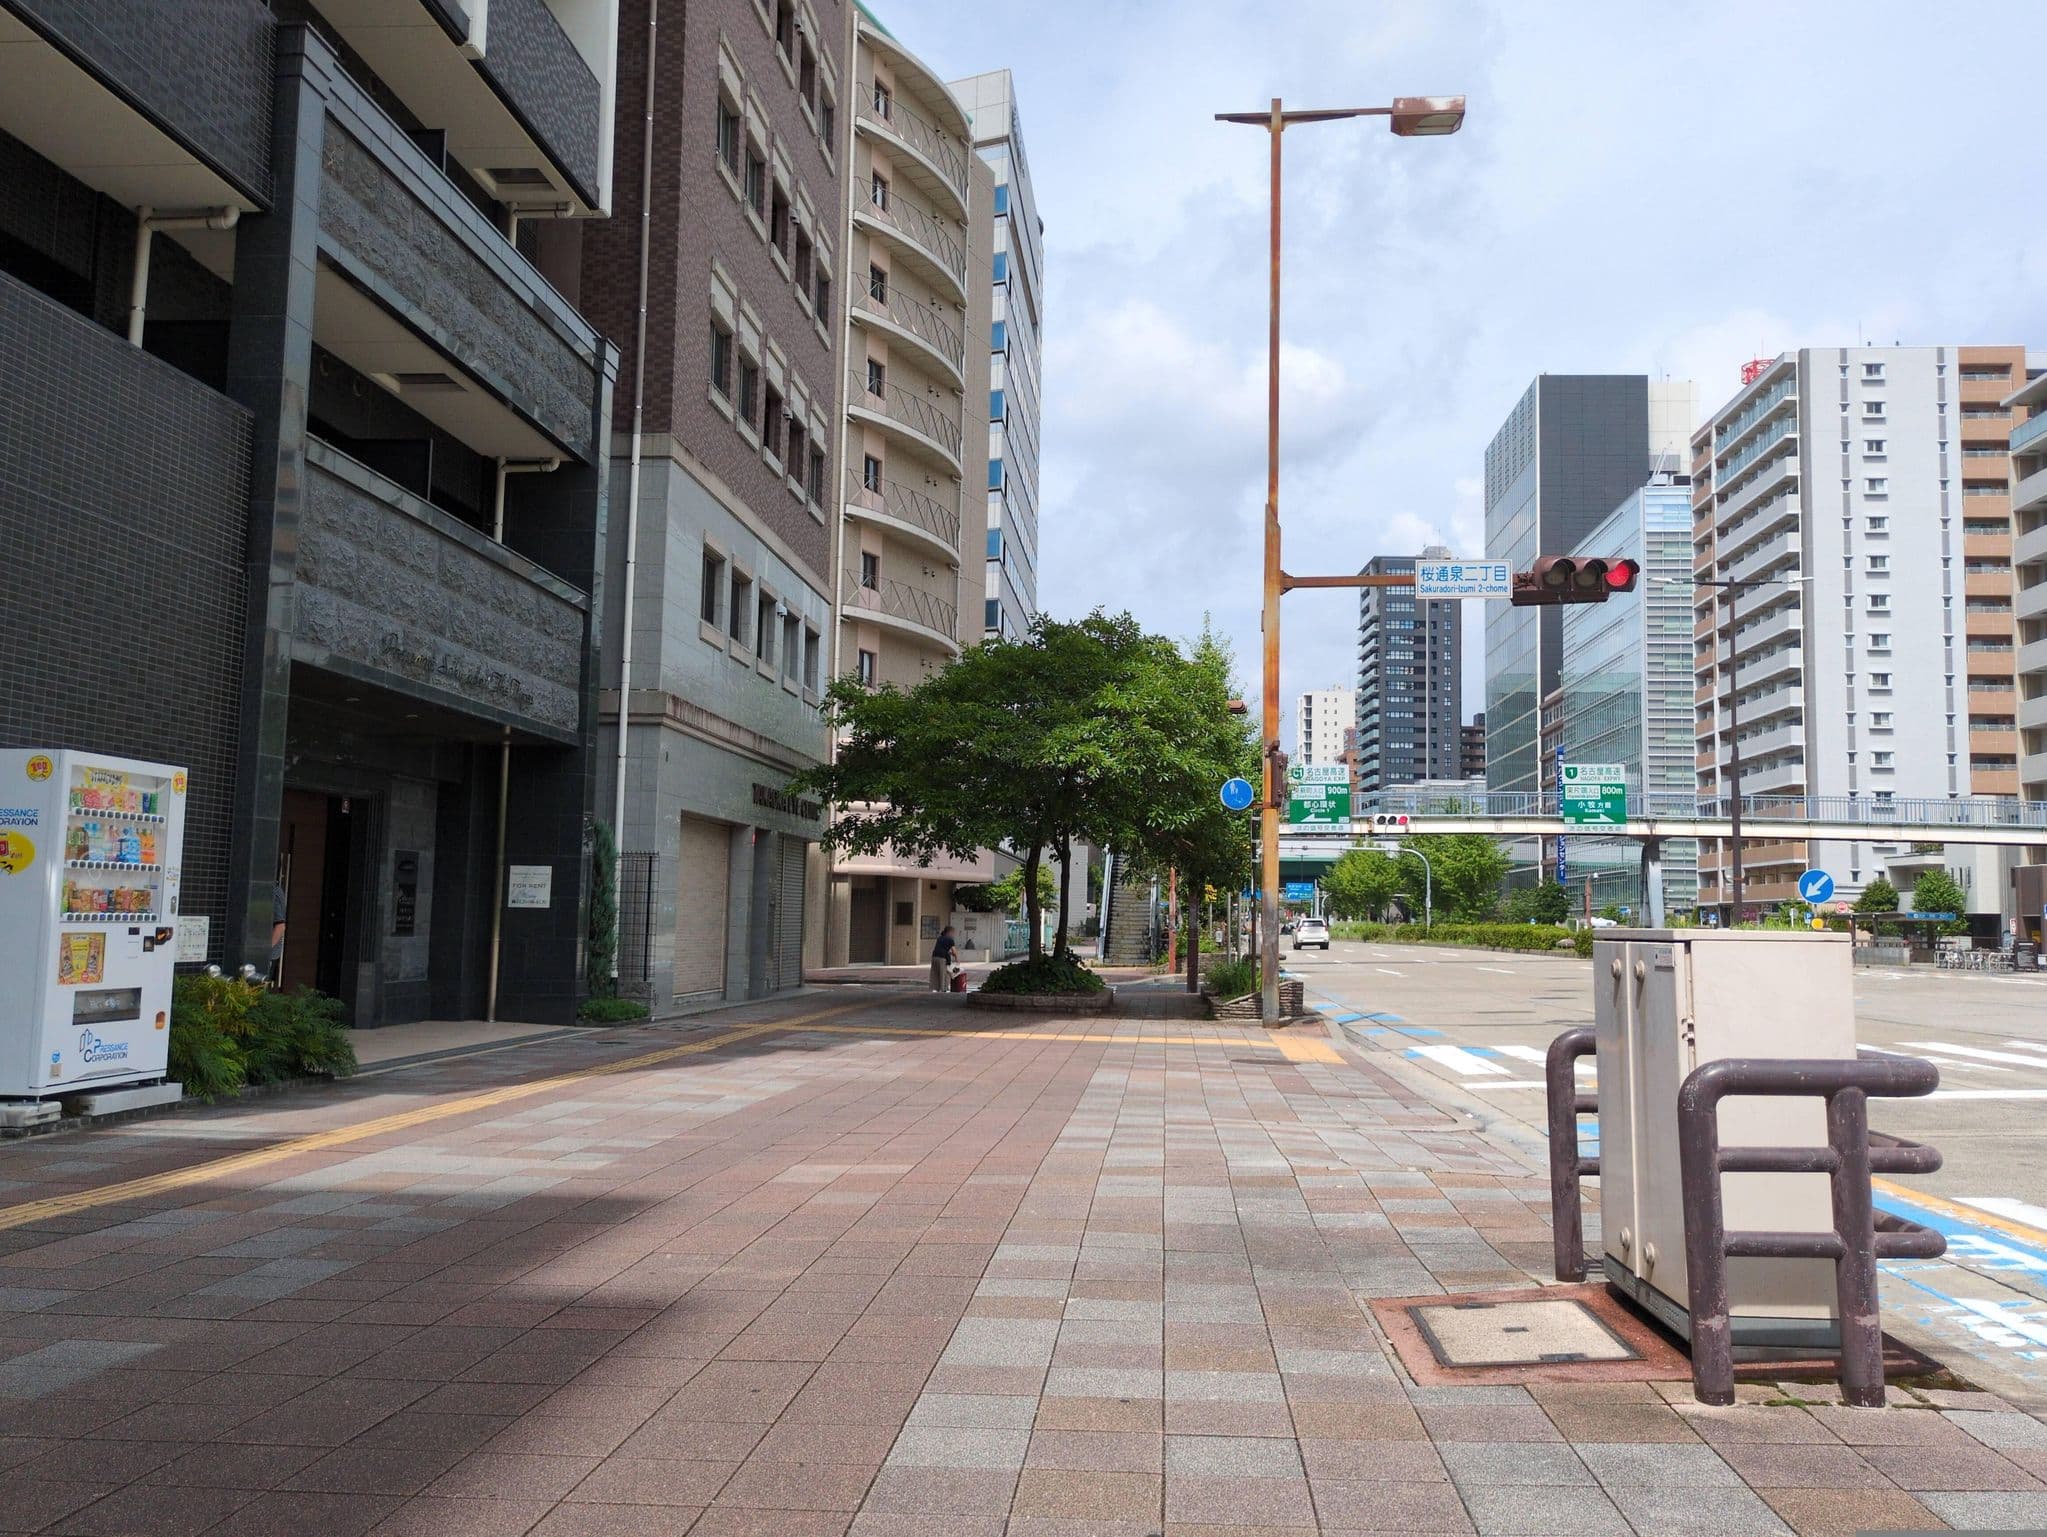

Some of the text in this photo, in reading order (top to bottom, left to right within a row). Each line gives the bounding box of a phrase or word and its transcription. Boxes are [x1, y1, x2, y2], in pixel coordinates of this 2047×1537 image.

[1421, 565, 1506, 582] 桜通泉二丁目
[1420, 584, 1508, 593] Sakuradori-Izumi 2-chome
[1306, 767, 1346, 776] 名古屋高速
[1569, 769, 1574, 777] 1
[1580, 767, 1620, 776] 名古屋高速
[1327, 786, 1348, 795] 900m
[1601, 786, 1623, 795] 800m
[1304, 801, 1336, 809] 都心環状
[94, 1039, 128, 1054] PRESSANCE
[84, 1049, 128, 1063] CORPORATION
